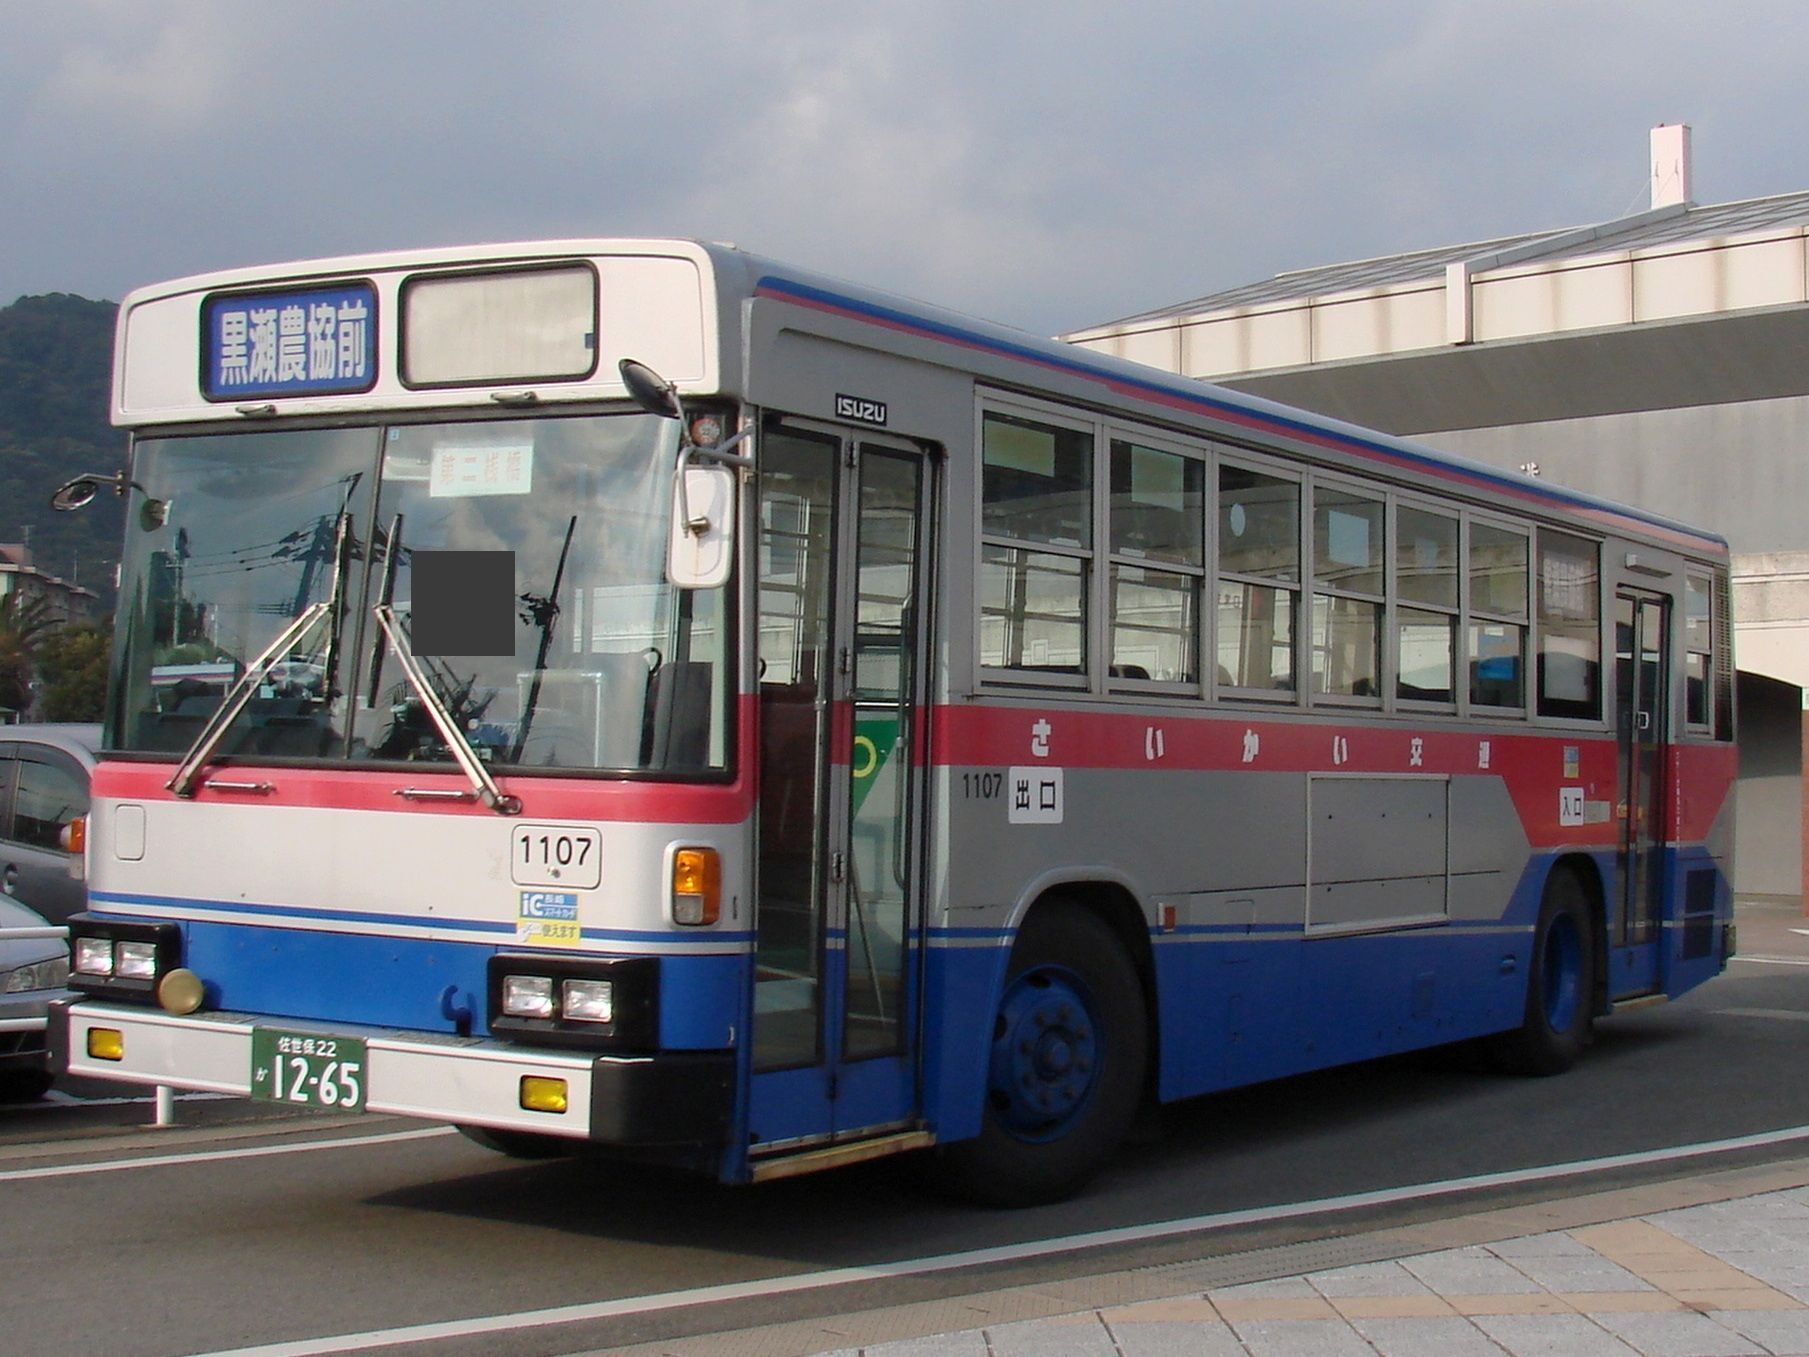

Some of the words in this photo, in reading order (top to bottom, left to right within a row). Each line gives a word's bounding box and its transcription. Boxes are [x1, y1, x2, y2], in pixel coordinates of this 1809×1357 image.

[219, 299, 368, 386] 黒瀬農協前
[837, 397, 885, 422] ISUZU
[963, 773, 1003, 799] 1107
[1016, 779, 1056, 811] 出口
[1563, 796, 1581, 817] 入口
[520, 835, 592, 866] 1107
[275, 1054, 360, 1108] 12-65
